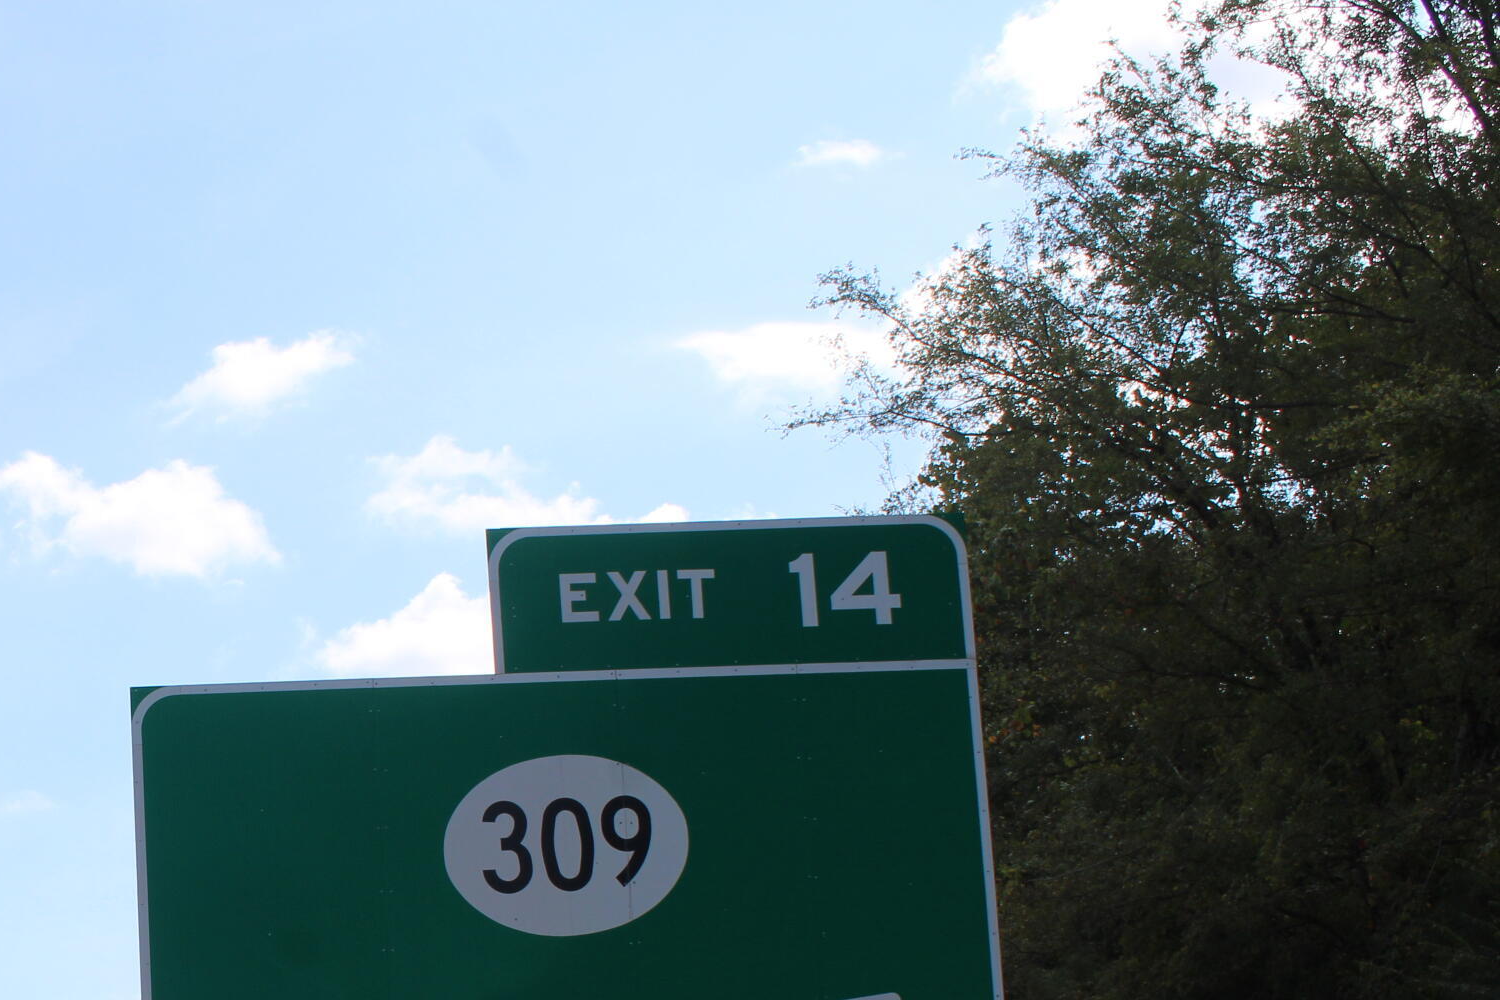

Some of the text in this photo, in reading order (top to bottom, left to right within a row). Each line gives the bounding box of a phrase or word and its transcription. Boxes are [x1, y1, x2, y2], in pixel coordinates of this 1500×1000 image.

[558, 551, 902, 626] EXIT 14
[481, 794, 652, 895] 309
